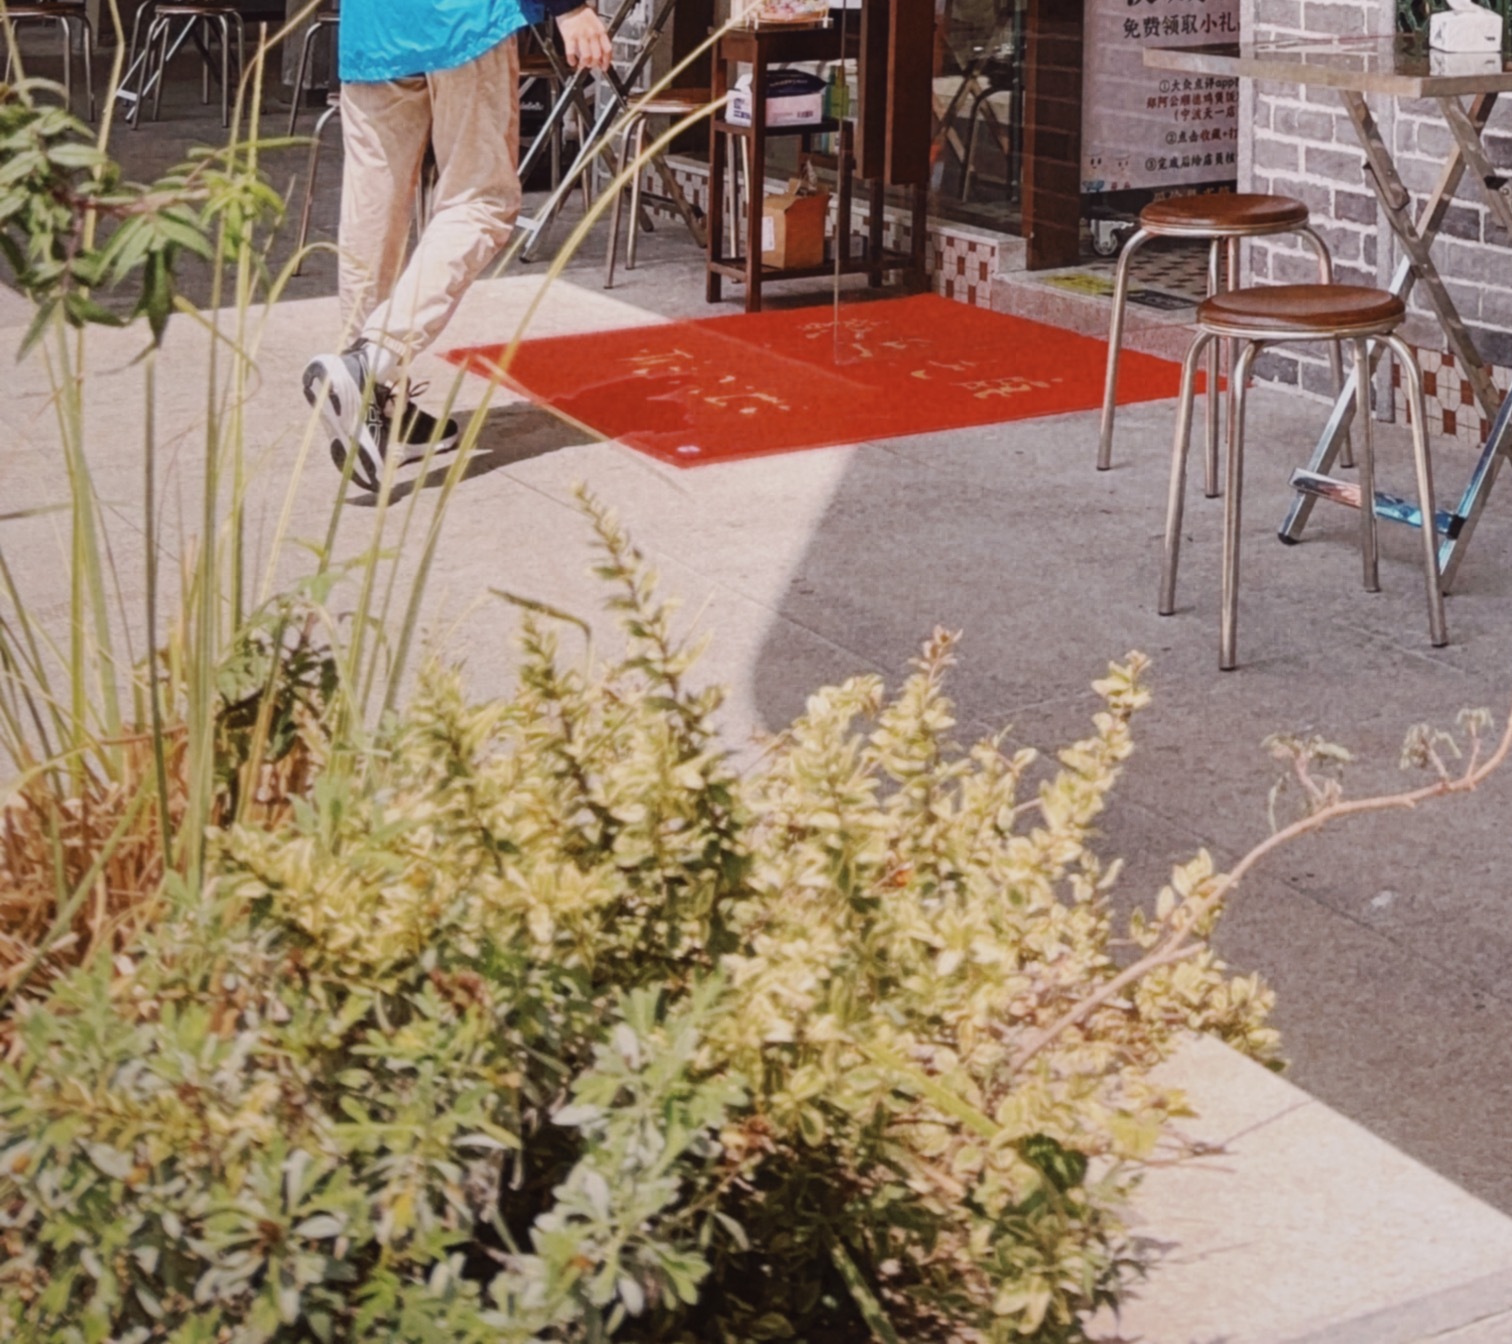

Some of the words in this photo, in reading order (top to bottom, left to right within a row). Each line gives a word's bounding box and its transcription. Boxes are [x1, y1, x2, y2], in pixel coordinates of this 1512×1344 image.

[1123, 11, 1241, 39] 免费领取小礼
[1146, 91, 1239, 110] 郑阿公顺德鸡煲饭
